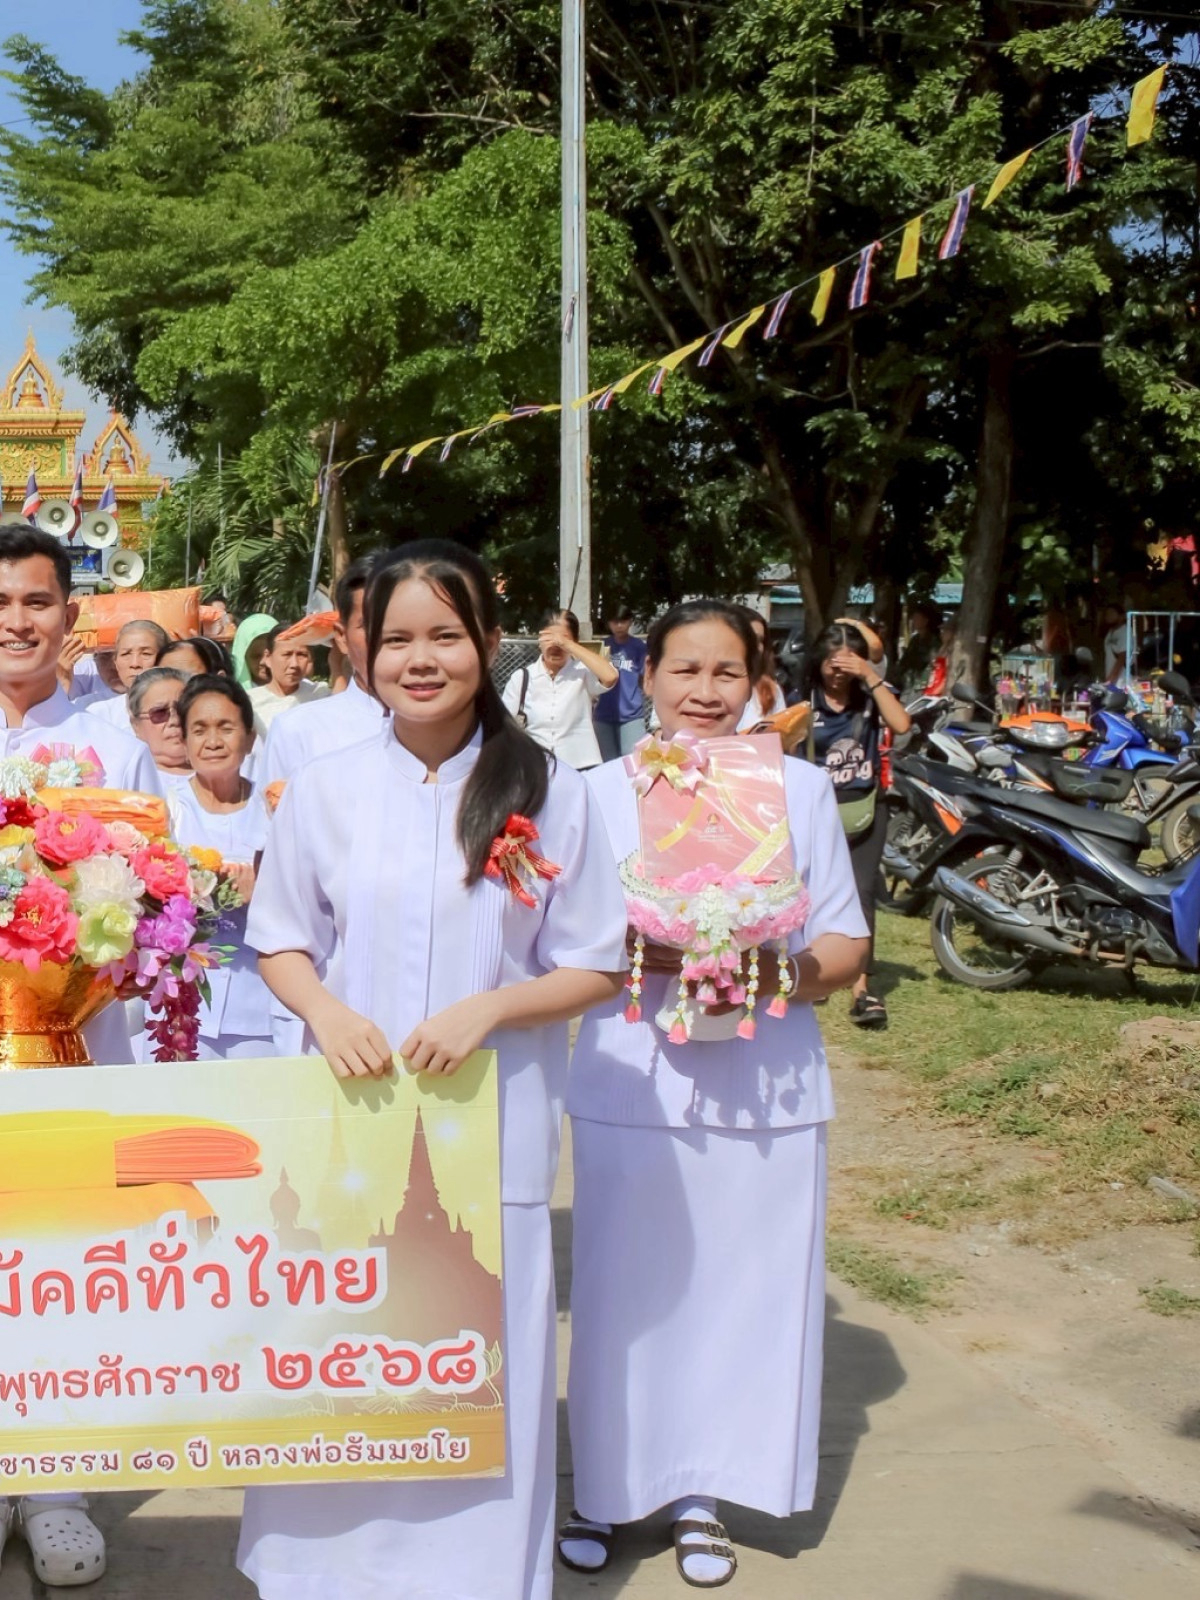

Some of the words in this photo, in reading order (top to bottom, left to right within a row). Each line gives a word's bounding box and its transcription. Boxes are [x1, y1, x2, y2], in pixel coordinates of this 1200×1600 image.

[262, 1339, 478, 1390] ๒๕๖๘
[133, 1450, 176, 1470] ๘๑
[188, 1439, 209, 1468] ปี
[222, 1431, 468, 1467] หลวงพ่อธัมมชโย
